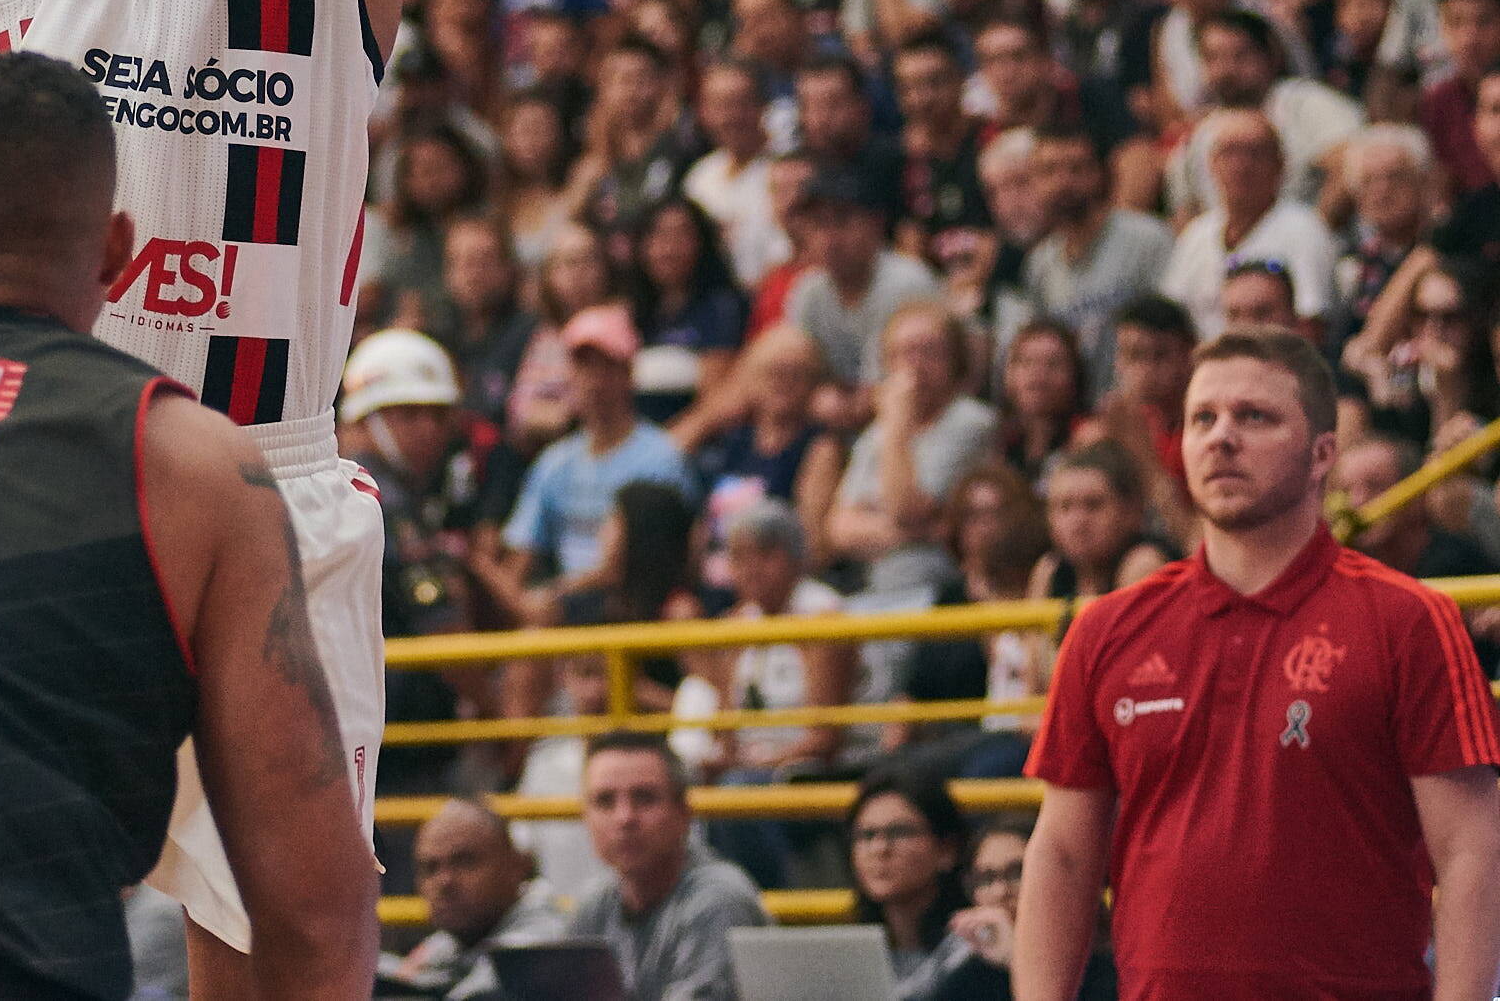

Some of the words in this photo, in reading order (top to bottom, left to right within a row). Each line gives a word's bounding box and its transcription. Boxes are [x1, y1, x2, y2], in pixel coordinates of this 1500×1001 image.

[80, 48, 173, 96] SEJA
[184, 57, 294, 106] SÓCIO
[130, 314, 194, 333] IDIOMAS
